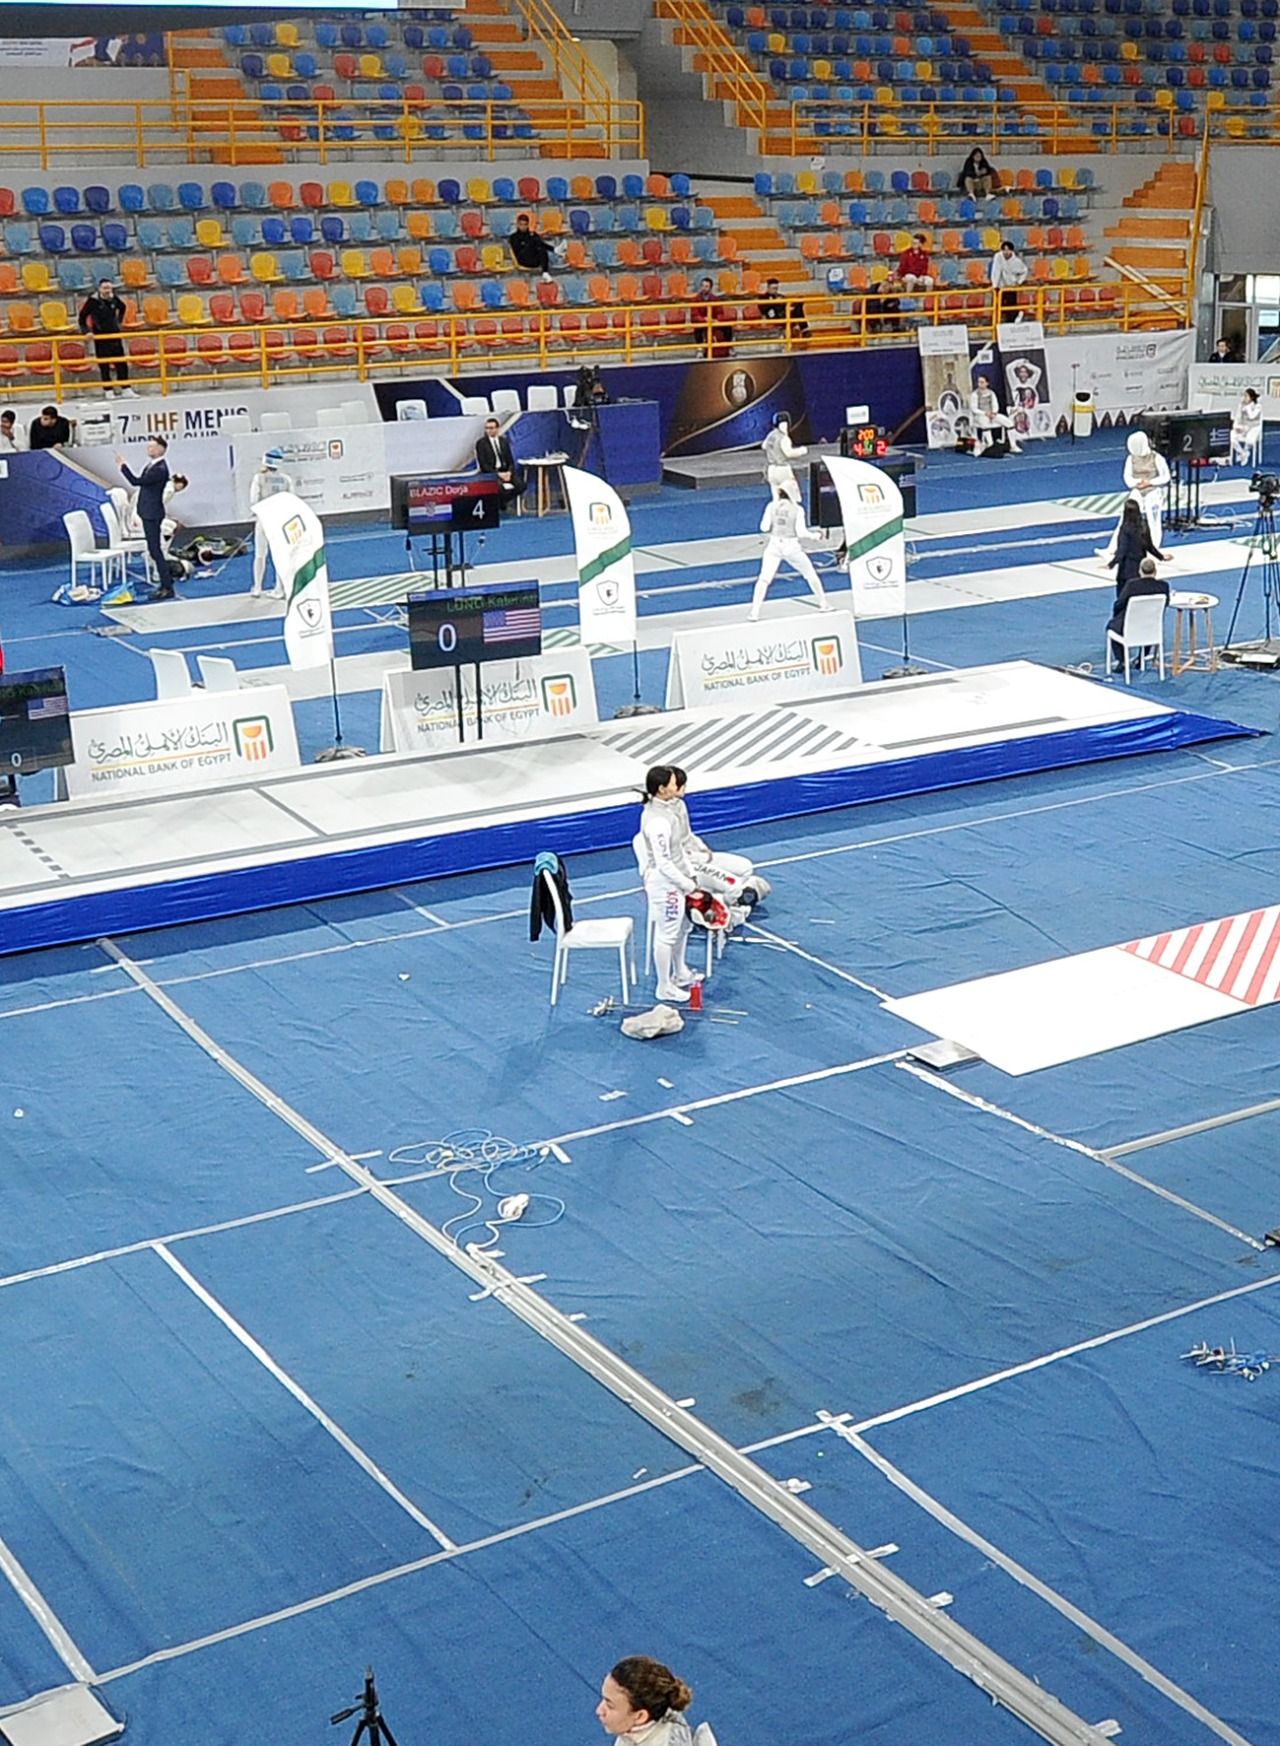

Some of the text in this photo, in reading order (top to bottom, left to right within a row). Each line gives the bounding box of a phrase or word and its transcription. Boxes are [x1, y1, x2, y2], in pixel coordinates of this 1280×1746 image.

[146, 411, 179, 433] IHF
[1182, 433, 1193, 452] 2
[471, 499, 486, 520] 4
[437, 622, 458, 653] 0
[703, 665, 811, 692] NATIONAL BANK OF EGYPT
[495, 712, 507, 723] OF
[510, 707, 541, 722] EGYPT
[10, 752, 22, 768] 0
[91, 752, 233, 783] NATIONAL BANK OF EGYPT
